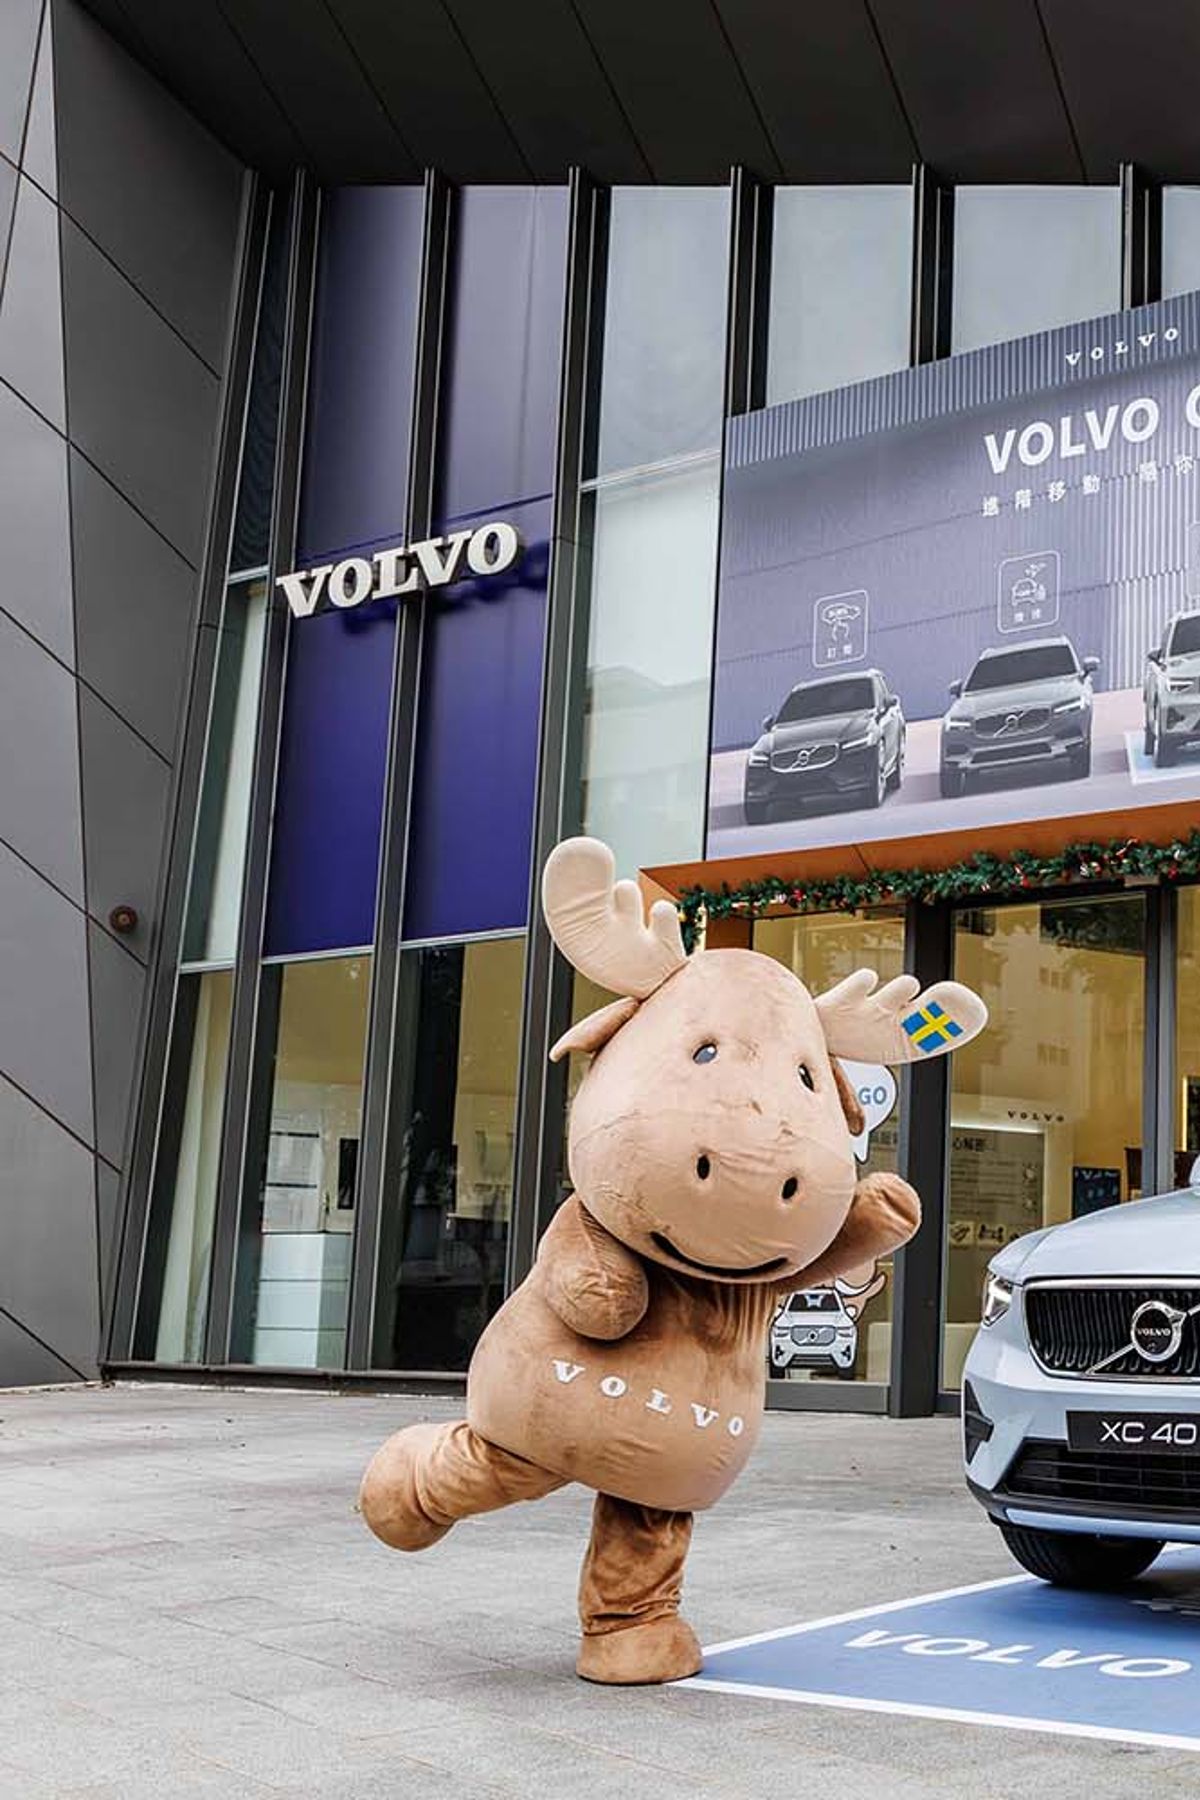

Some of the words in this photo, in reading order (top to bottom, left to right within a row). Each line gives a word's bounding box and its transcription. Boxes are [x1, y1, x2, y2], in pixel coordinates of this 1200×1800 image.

[1065, 328, 1179, 366] VOLVO
[983, 397, 1160, 474] VOLVO
[275, 522, 518, 618] VOLVO
[859, 1086, 887, 1105] GO
[1007, 1110, 1064, 1122] VOLVO
[1137, 1327, 1171, 1336] VOLVO
[552, 1360, 744, 1436] VOLVO
[1100, 1421, 1145, 1443] XC
[1150, 1422, 1197, 1444] 40
[843, 1629, 1192, 1678] VOLVO
